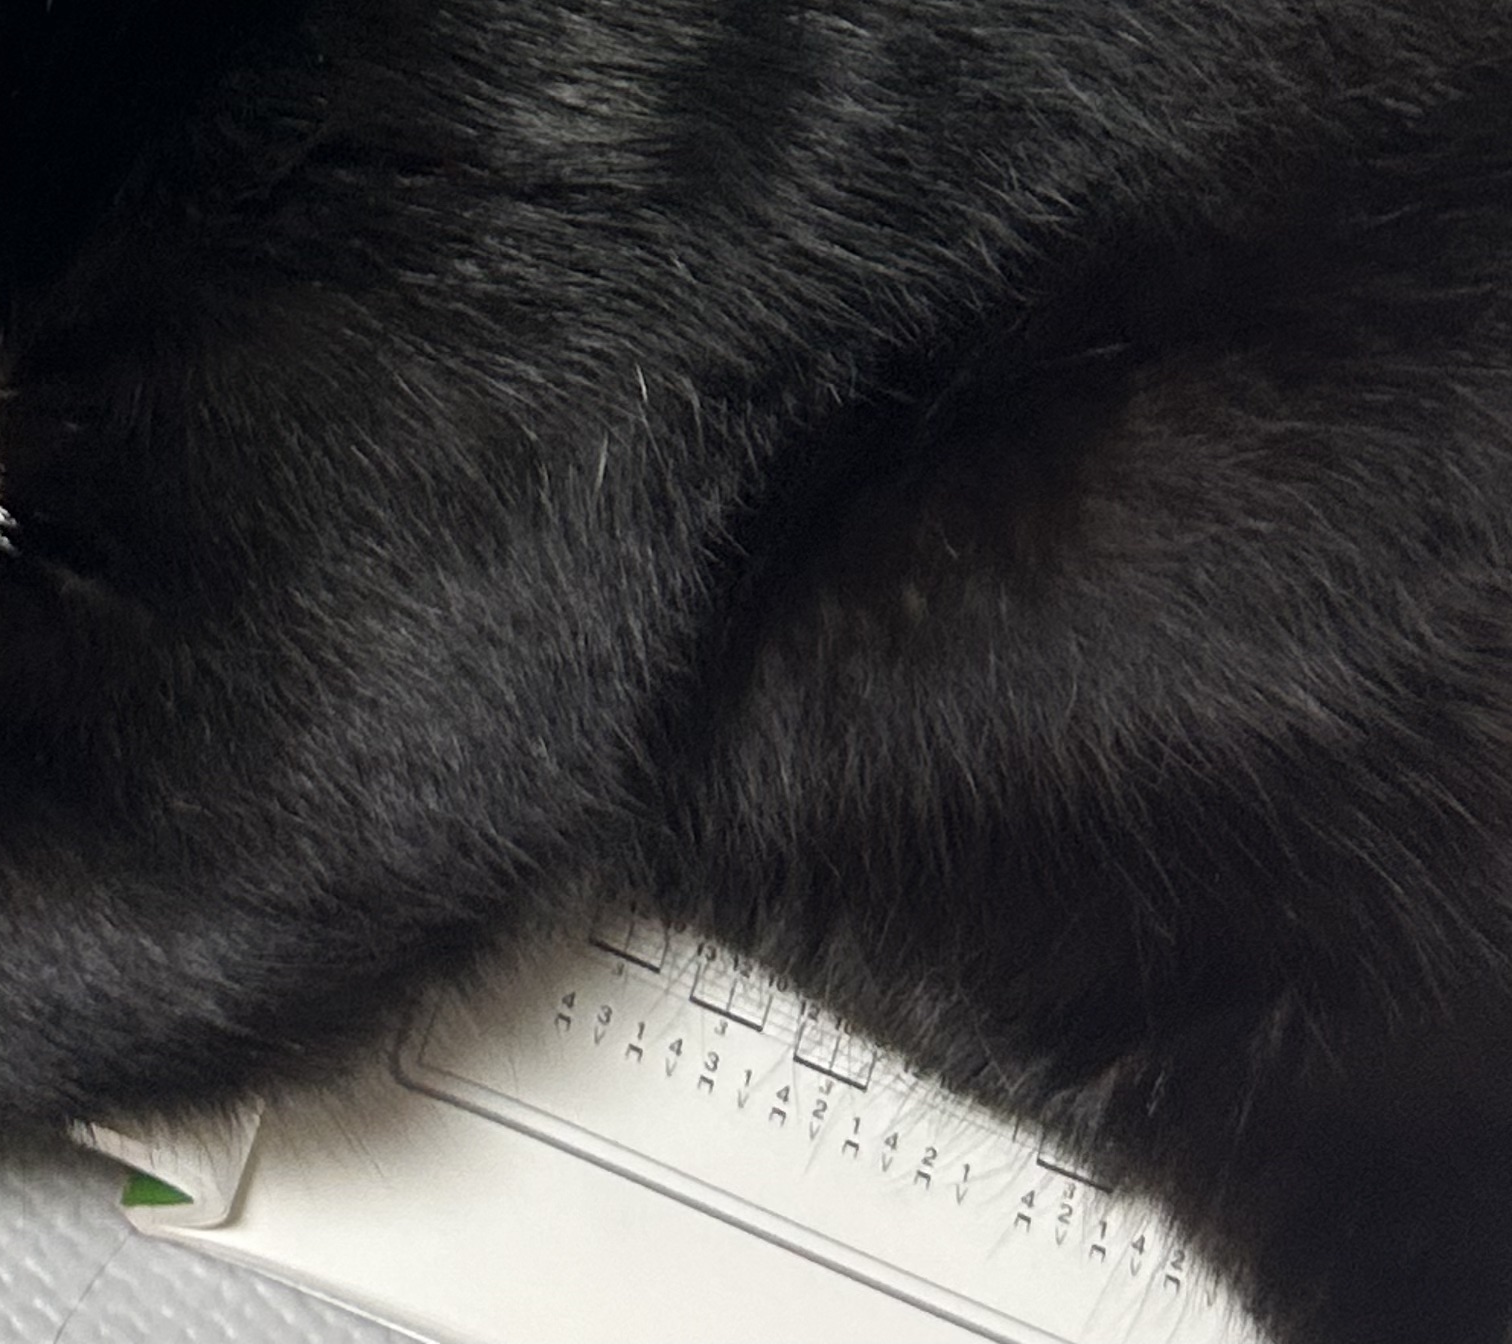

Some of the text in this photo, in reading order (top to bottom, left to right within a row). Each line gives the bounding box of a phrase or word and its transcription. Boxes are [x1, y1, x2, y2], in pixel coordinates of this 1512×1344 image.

[560, 991, 577, 1010] 4
[595, 1004, 613, 1026] 3
[668, 1037, 684, 1058] 4
[704, 1050, 720, 1074] 3
[775, 1084, 791, 1104] 4
[812, 1098, 829, 1120] 2
[884, 1131, 899, 1152] 4
[921, 1145, 938, 1168] 2
[1019, 1189, 1036, 1210] 4
[1057, 1202, 1074, 1225] 2
[1130, 1233, 1146, 1256] 4
